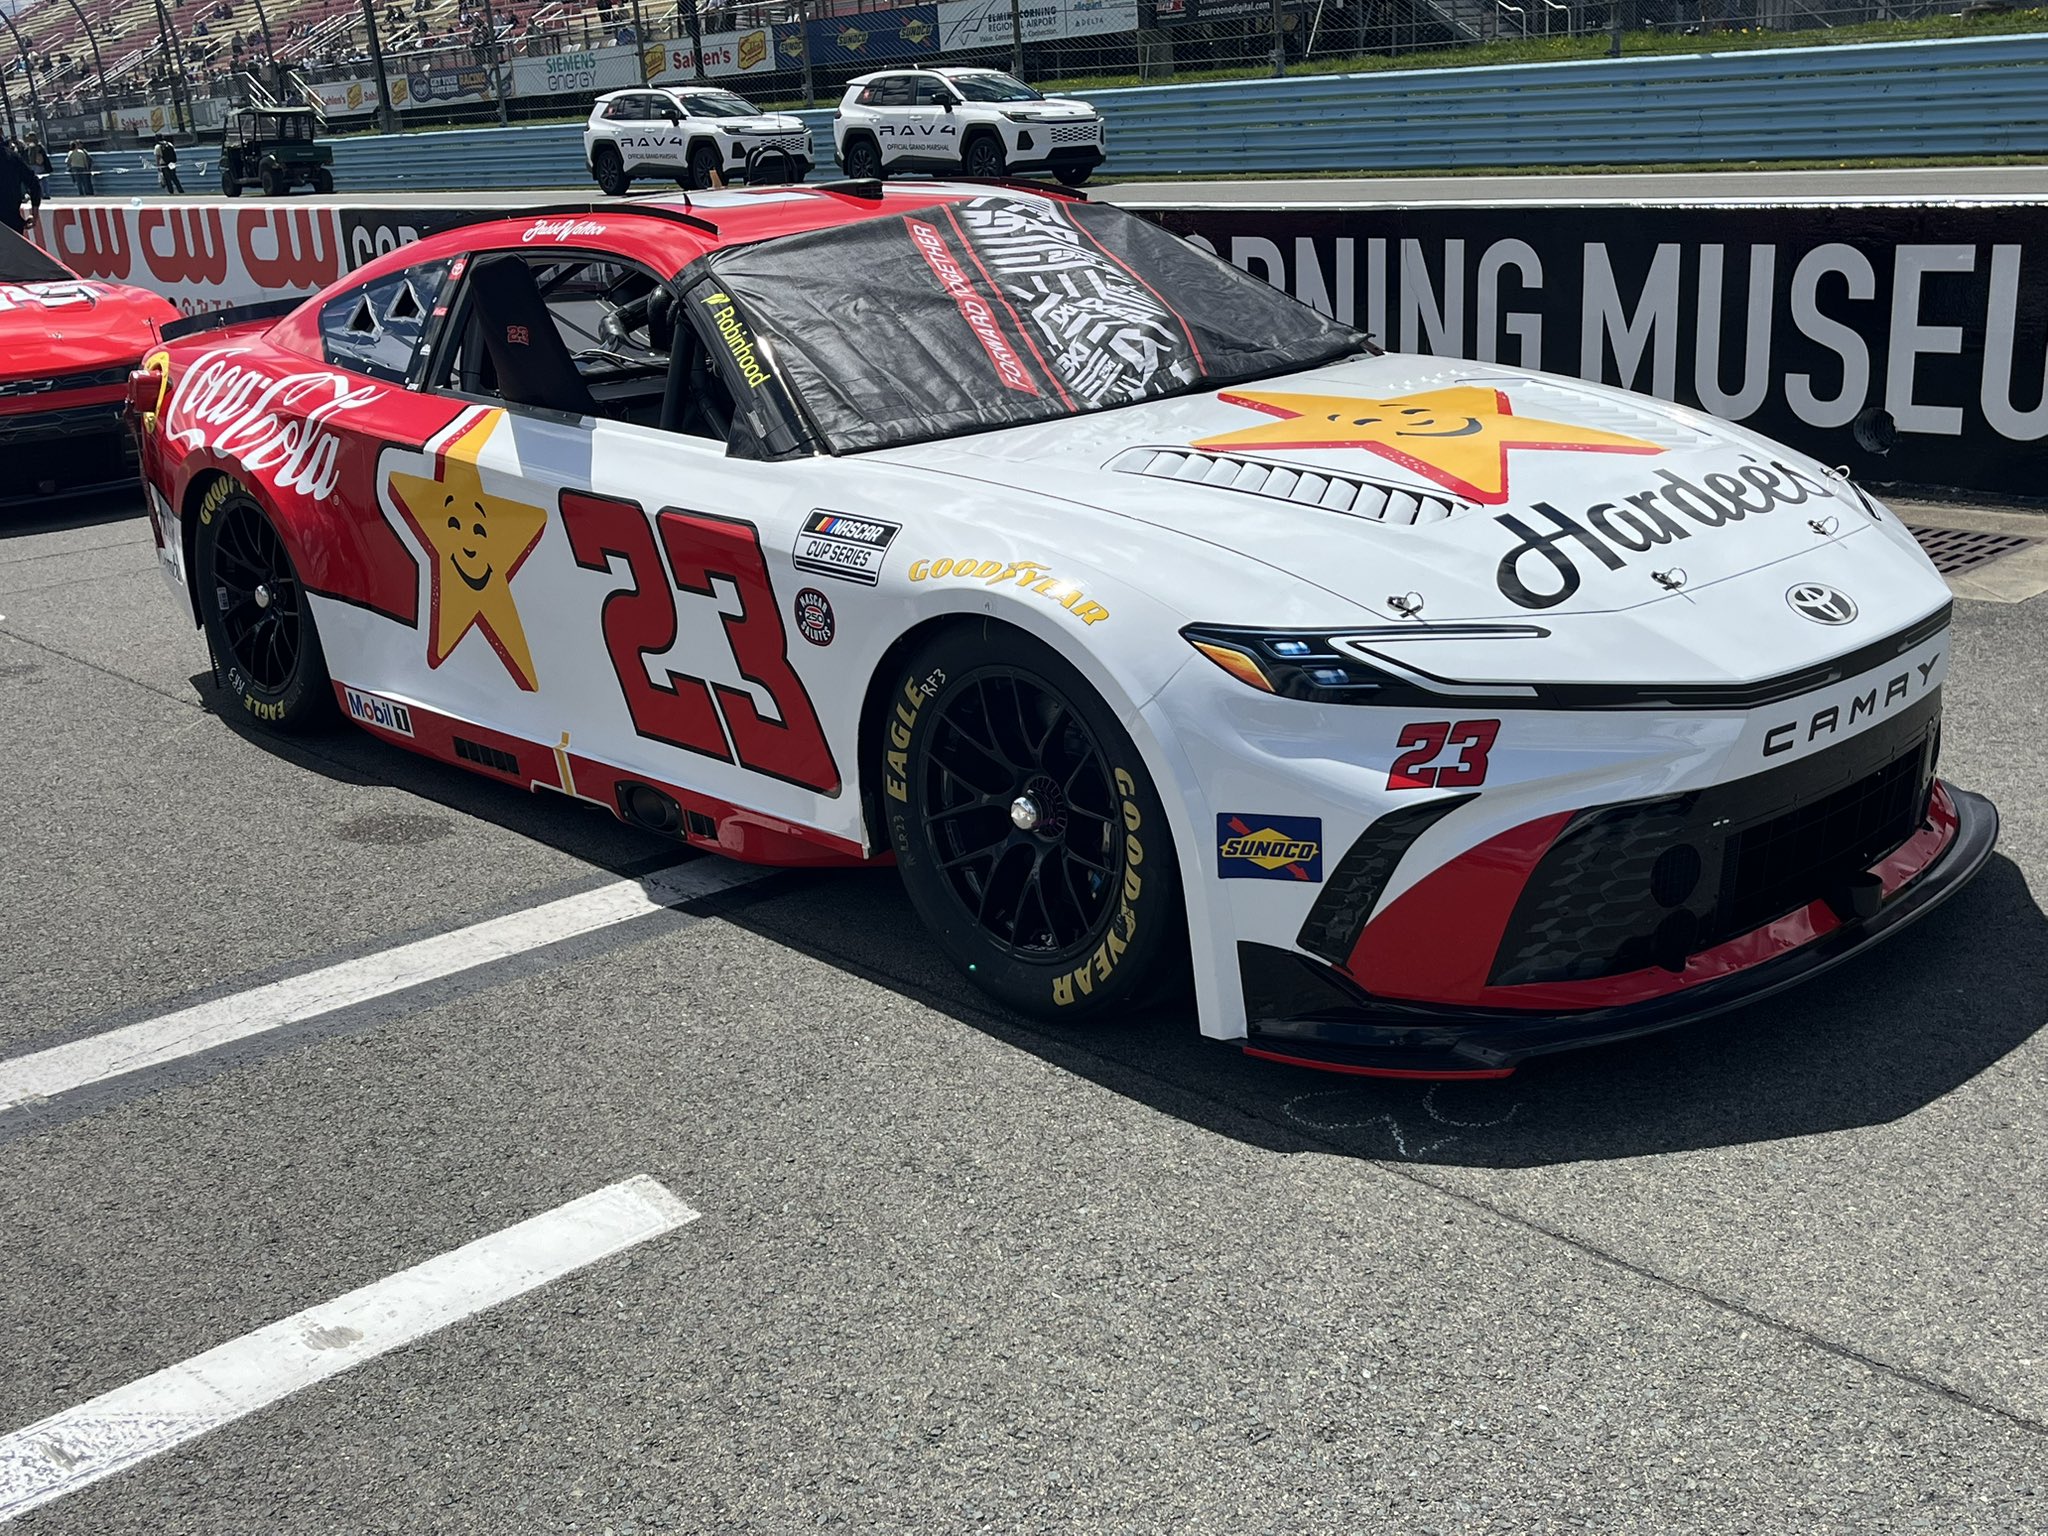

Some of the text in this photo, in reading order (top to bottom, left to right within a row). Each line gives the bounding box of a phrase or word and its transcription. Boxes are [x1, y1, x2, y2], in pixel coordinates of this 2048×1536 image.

[1198, 2, 1270, 16] sourceonedigital.com
[901, 26, 931, 38] SUNOCO
[988, 17, 1057, 32] REGIONL AIRPORT
[1081, 18, 1104, 26] DELTA
[838, 34, 867, 45] SUNOCO
[546, 53, 596, 74] SIEMENS
[621, 137, 682, 147] RAV4
[880, 125, 956, 135] RAV4
[913, 224, 1029, 388] FORWARD TOGETHER
[506, 325, 530, 346] 23
[713, 305, 771, 388] Robinhood
[1581, 243, 2048, 442] MUSEU
[830, 519, 885, 542] NASCAR
[1494, 453, 1835, 610] Hardee's
[806, 540, 872, 567] CUP SERIES
[799, 593, 828, 614] NASCAR
[908, 557, 1111, 626] GOODYEAR
[806, 611, 824, 623] 250
[558, 487, 843, 800] 23
[800, 620, 831, 642] SALUTES
[920, 667, 946, 697] RF3
[243, 693, 286, 721] EAGLE
[347, 691, 394, 728] Mobil
[1762, 652, 1941, 758] CAMRY
[887, 676, 925, 803] EAGLE
[1385, 718, 1501, 791] 23
[1223, 839, 1317, 860] SUNOCO
[1051, 767, 1144, 1007] GOODYEAR
